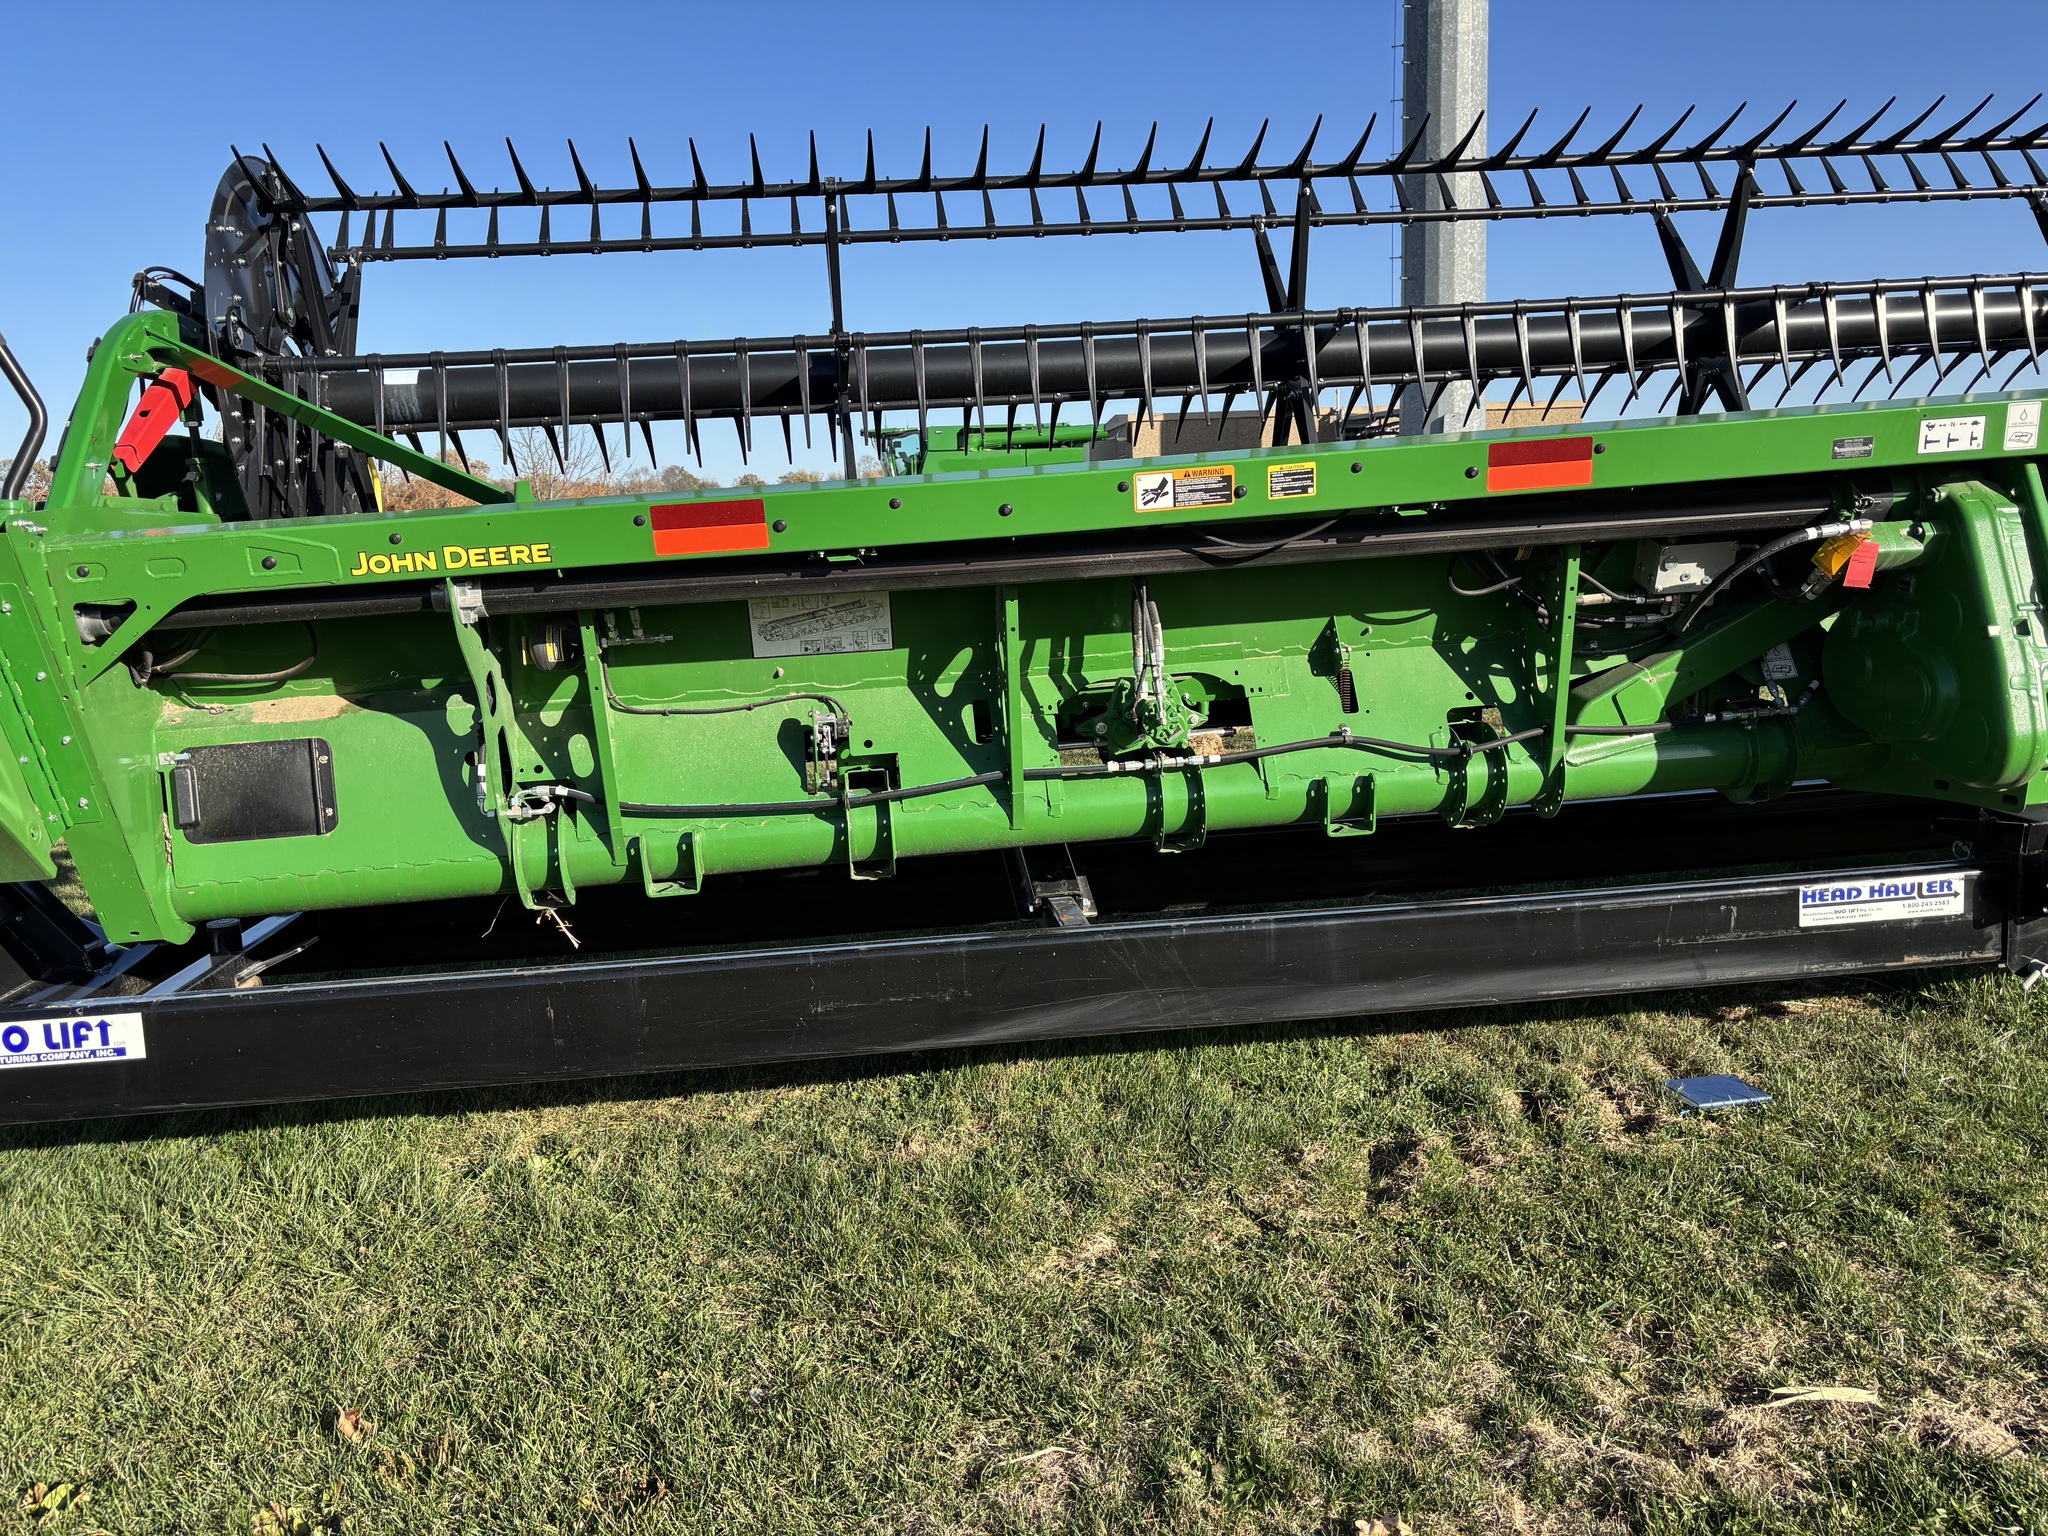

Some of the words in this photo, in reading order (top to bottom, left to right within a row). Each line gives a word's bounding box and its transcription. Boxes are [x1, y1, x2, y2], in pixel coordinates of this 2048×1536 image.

[1191, 468, 1225, 477] WARNING
[350, 550, 438, 576] JOHN
[442, 543, 552, 569] DEERE
[1802, 887, 1862, 903] HEAD
[1869, 880, 1953, 899] HAULER
[40, 1050, 94, 1062] COMPANY,
[96, 1048, 117, 1057] INC.
